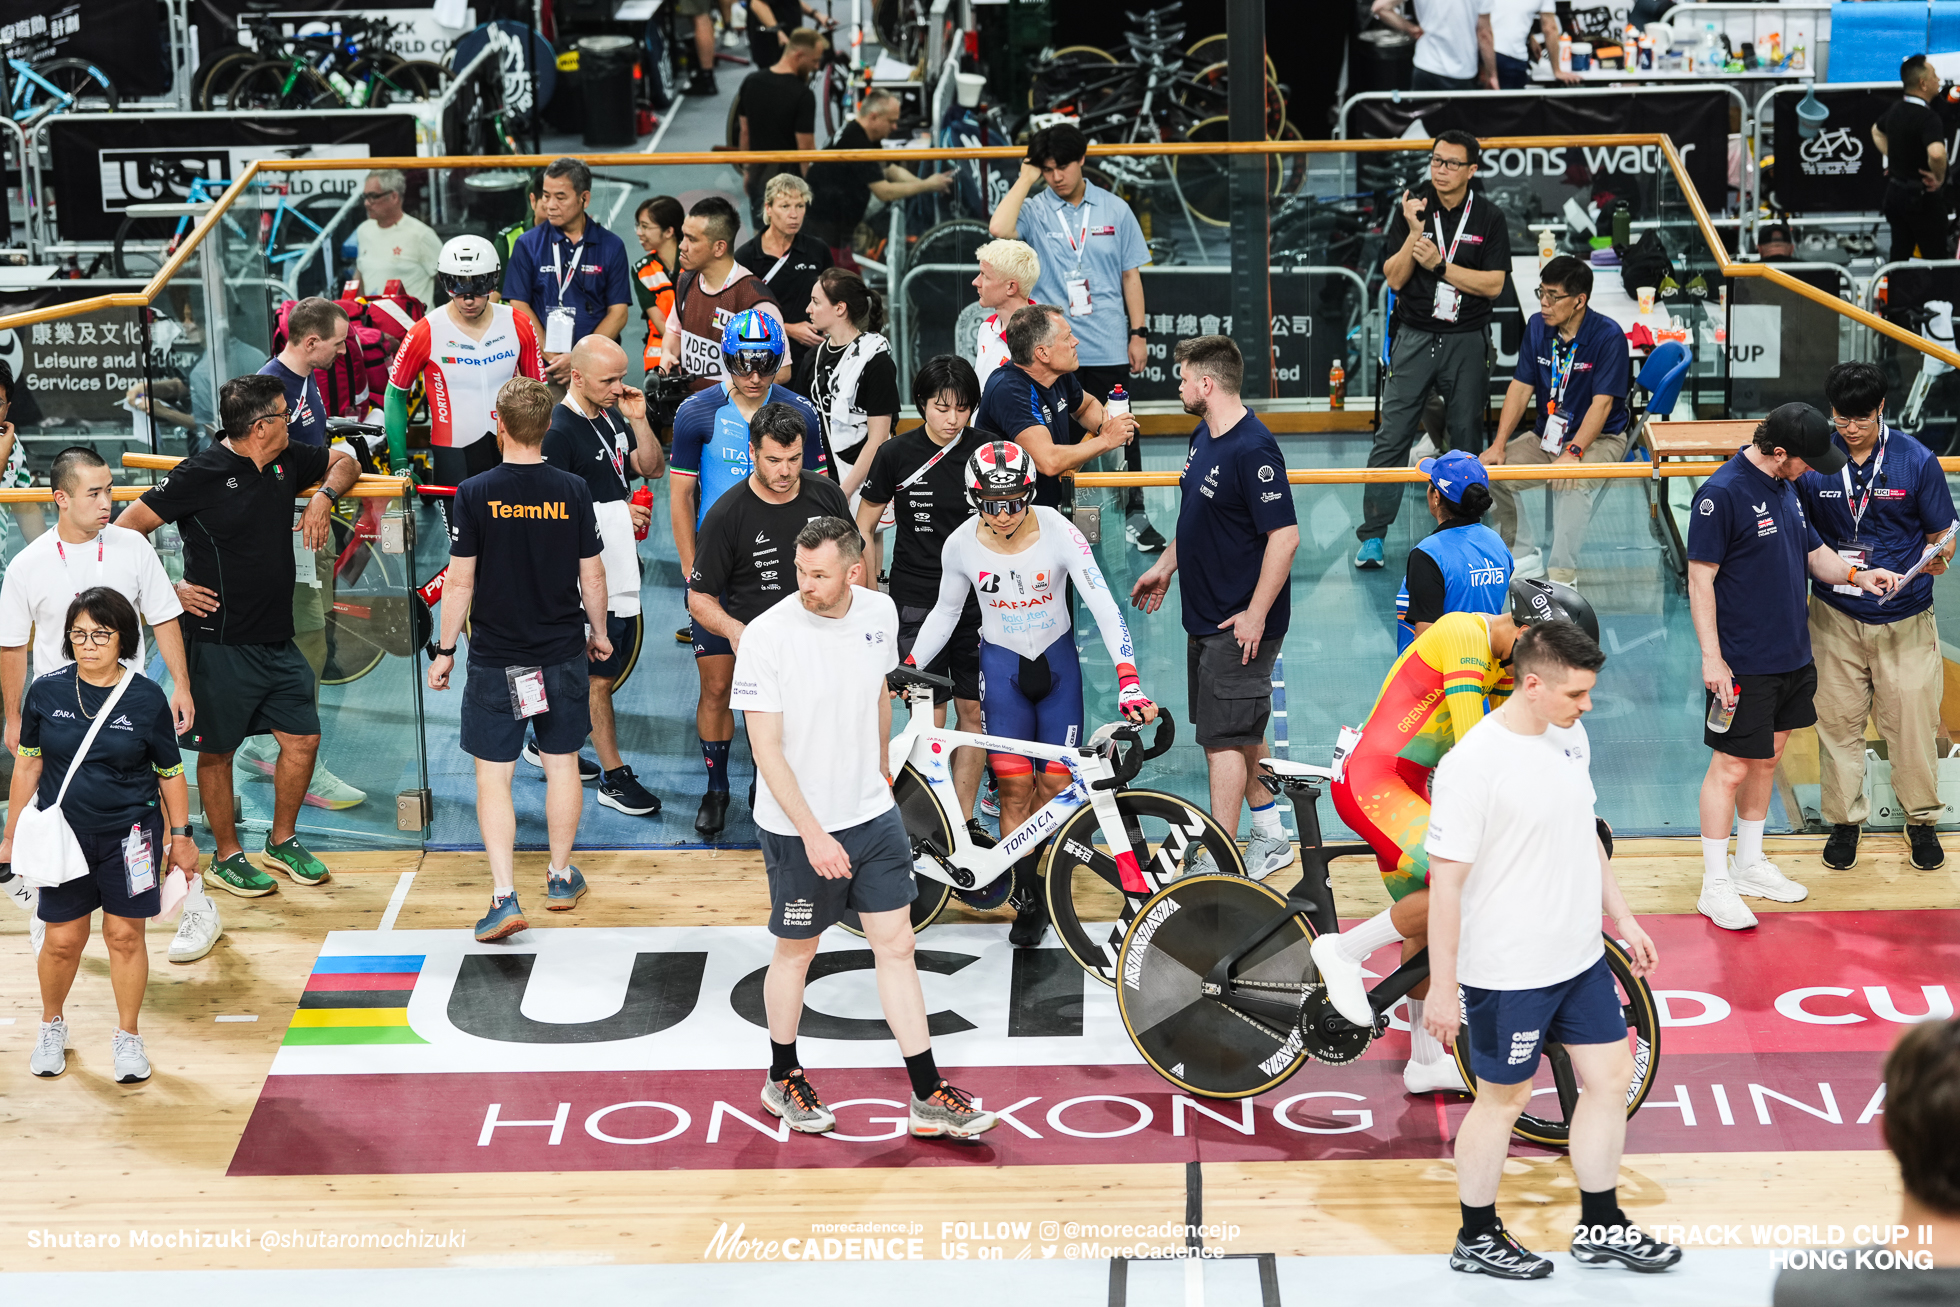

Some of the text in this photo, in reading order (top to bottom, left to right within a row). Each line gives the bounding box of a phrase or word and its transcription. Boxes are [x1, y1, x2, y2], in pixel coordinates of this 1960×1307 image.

[320, 178, 357, 196] CUP
[34, 352, 98, 370] Leisure
[102, 351, 136, 369] and
[389, 333, 415, 382] PORTUGAL
[456, 350, 516, 367] PORTUGAL
[529, 319, 547, 384] PORTUGAL
[26, 373, 101, 391] Services
[438, 371, 450, 424] PORTUGAL
[487, 500, 570, 520] TeamNL
[1468, 559, 1505, 587] india
[989, 592, 1053, 610] JAPAN
[1397, 687, 1446, 734] GRENADA
[1003, 810, 1055, 856] TORAYCA
